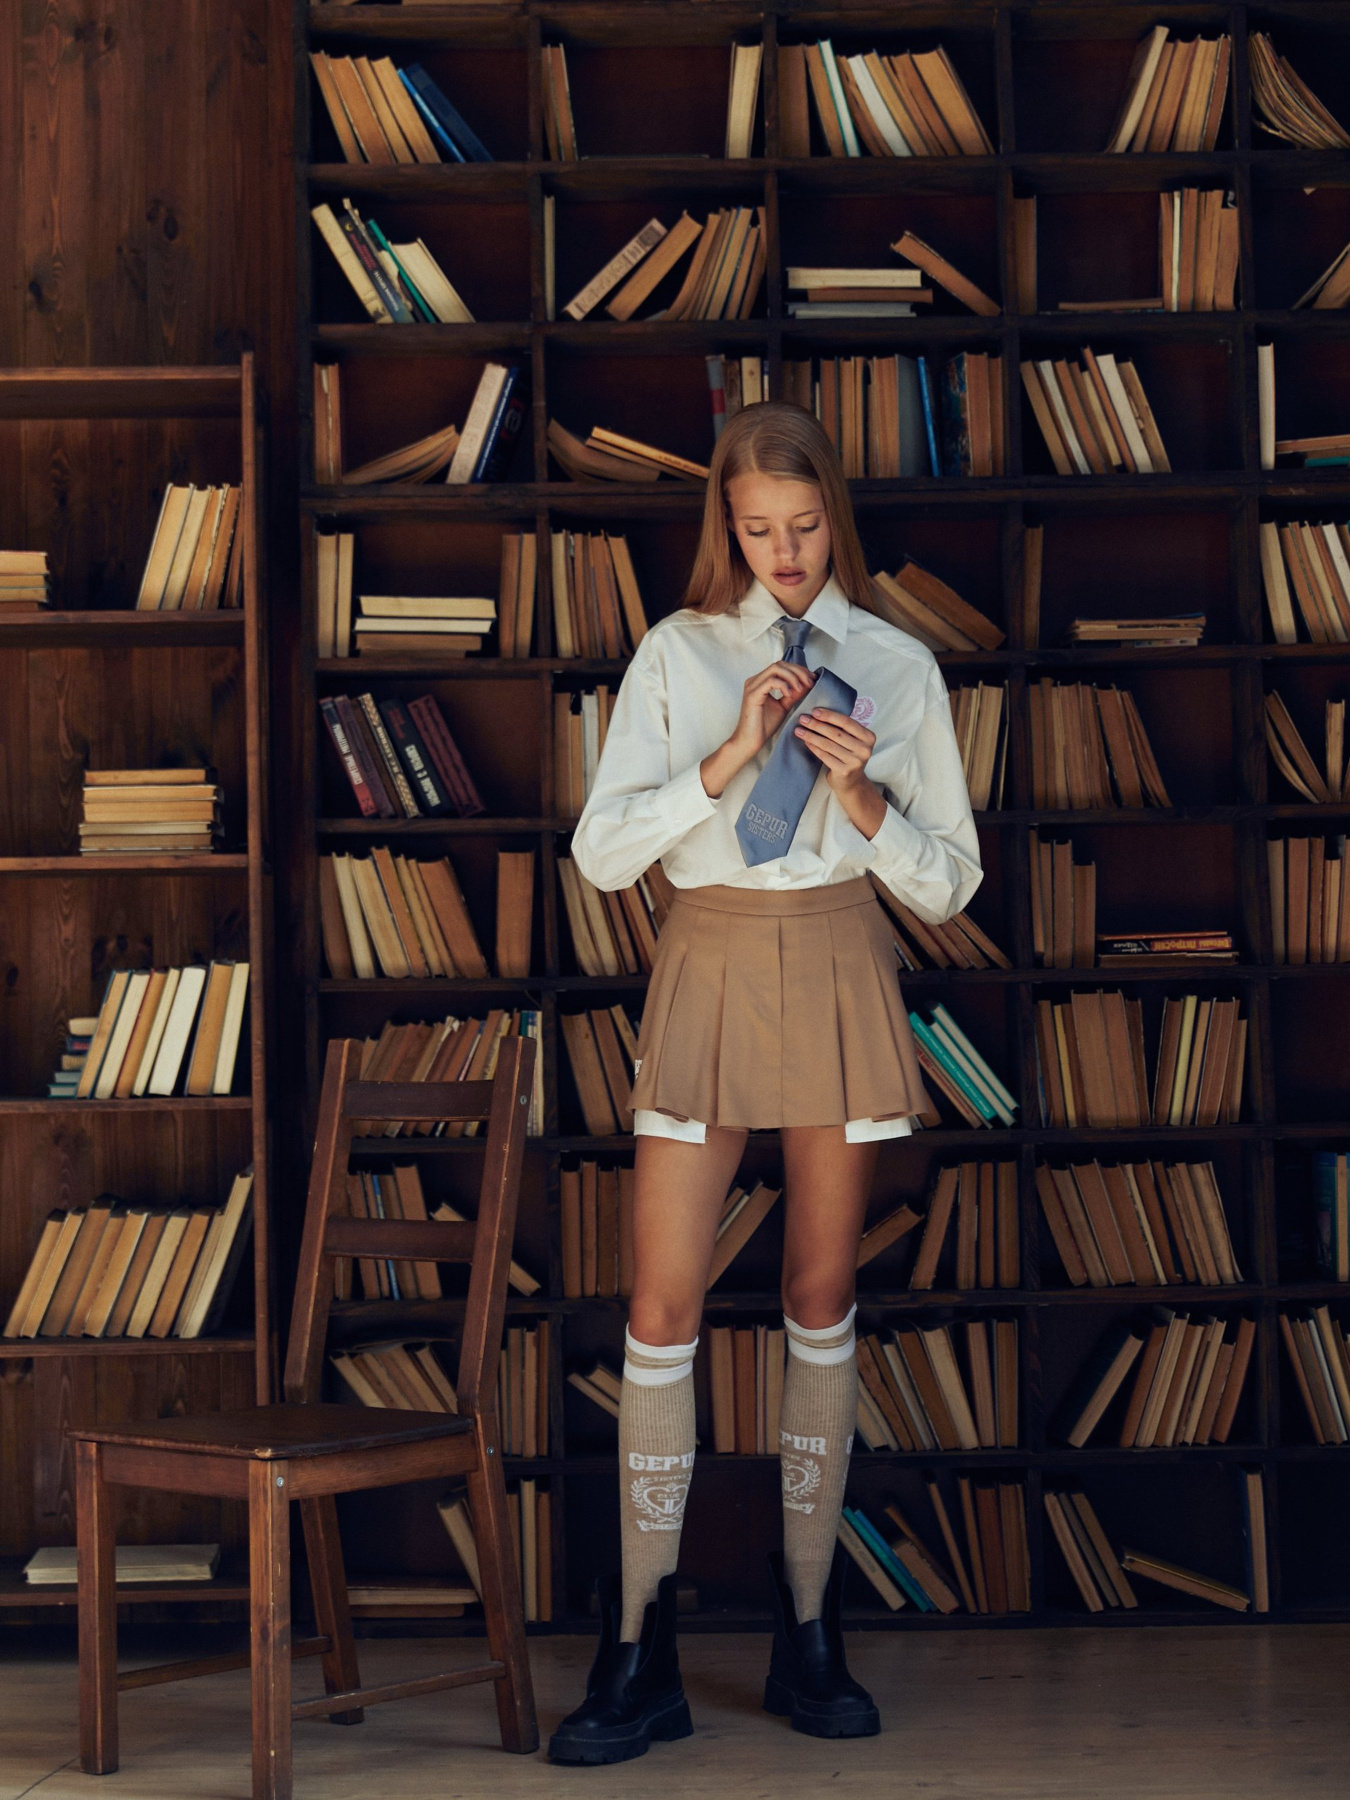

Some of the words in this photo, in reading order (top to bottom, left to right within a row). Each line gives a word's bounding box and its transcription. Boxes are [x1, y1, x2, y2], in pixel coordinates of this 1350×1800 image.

[745, 803, 789, 840] GEPUR
[746, 821, 777, 844] SISTERS
[779, 1430, 827, 1456] PUR
[628, 1449, 696, 1472] GEPU
